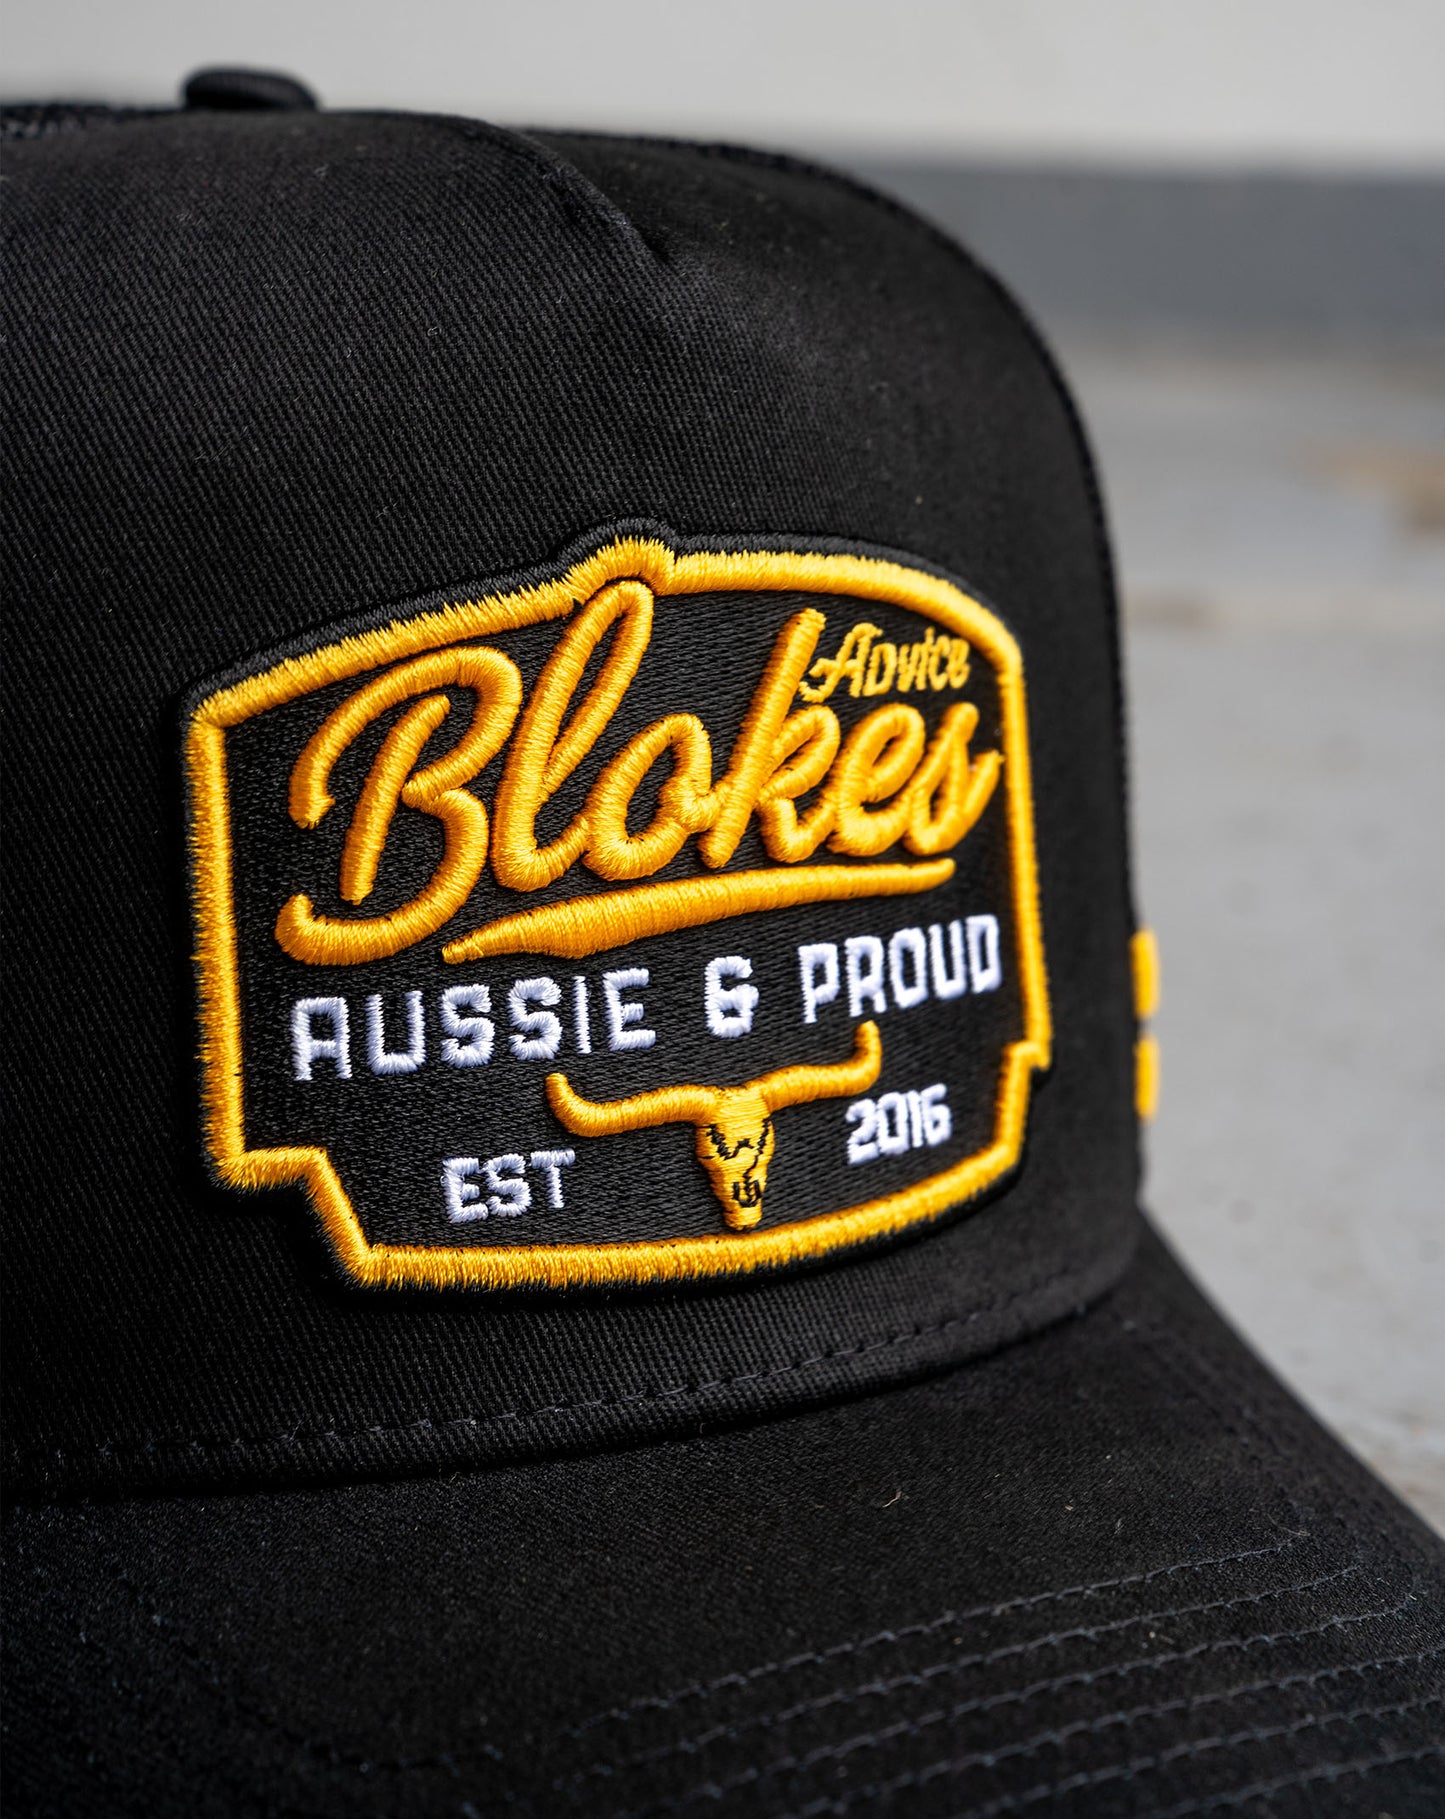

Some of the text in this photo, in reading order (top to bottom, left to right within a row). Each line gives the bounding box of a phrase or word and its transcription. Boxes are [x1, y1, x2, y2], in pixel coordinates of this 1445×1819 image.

[275, 582, 1003, 964] Blokes
[291, 968, 656, 1080] AUSSIE
[798, 914, 1001, 1024] PROUD
[846, 1084, 952, 1164] 2016
[440, 1149, 576, 1223] EST
